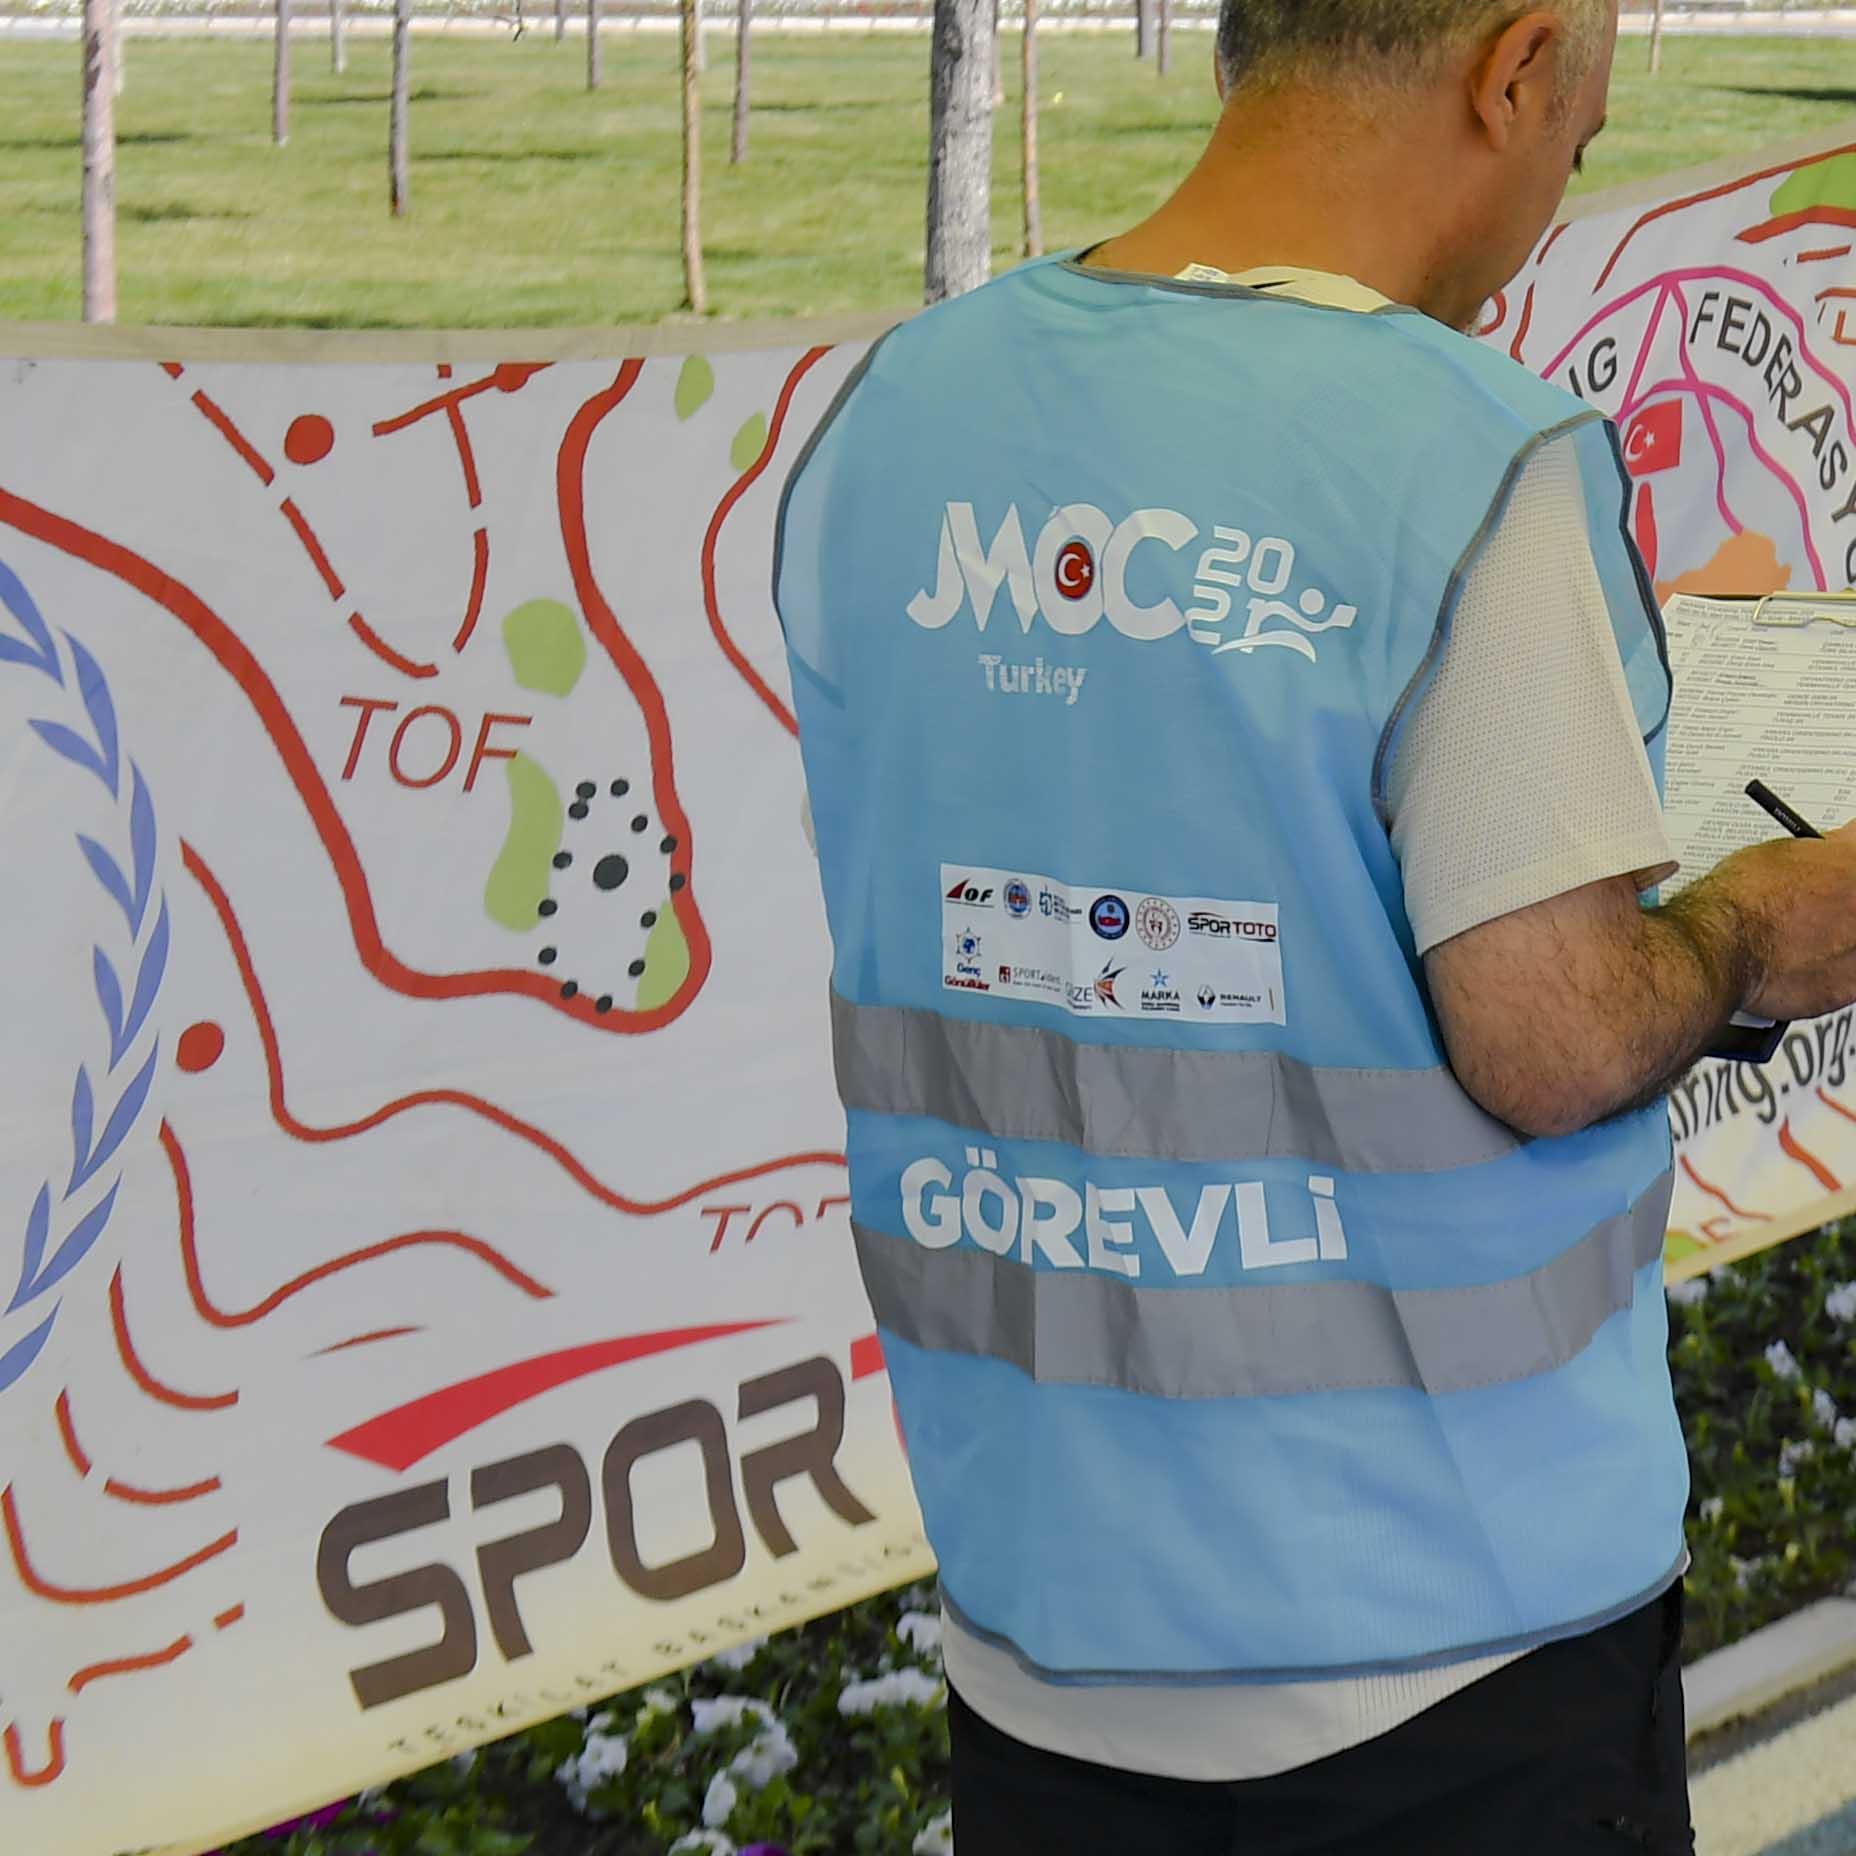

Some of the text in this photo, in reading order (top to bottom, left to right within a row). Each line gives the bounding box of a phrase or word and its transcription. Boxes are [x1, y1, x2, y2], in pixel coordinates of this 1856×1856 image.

[976, 652, 1088, 706] Turkey
[338, 695, 533, 793] TOF
[899, 1145, 1349, 1278] GÖREVLİ
